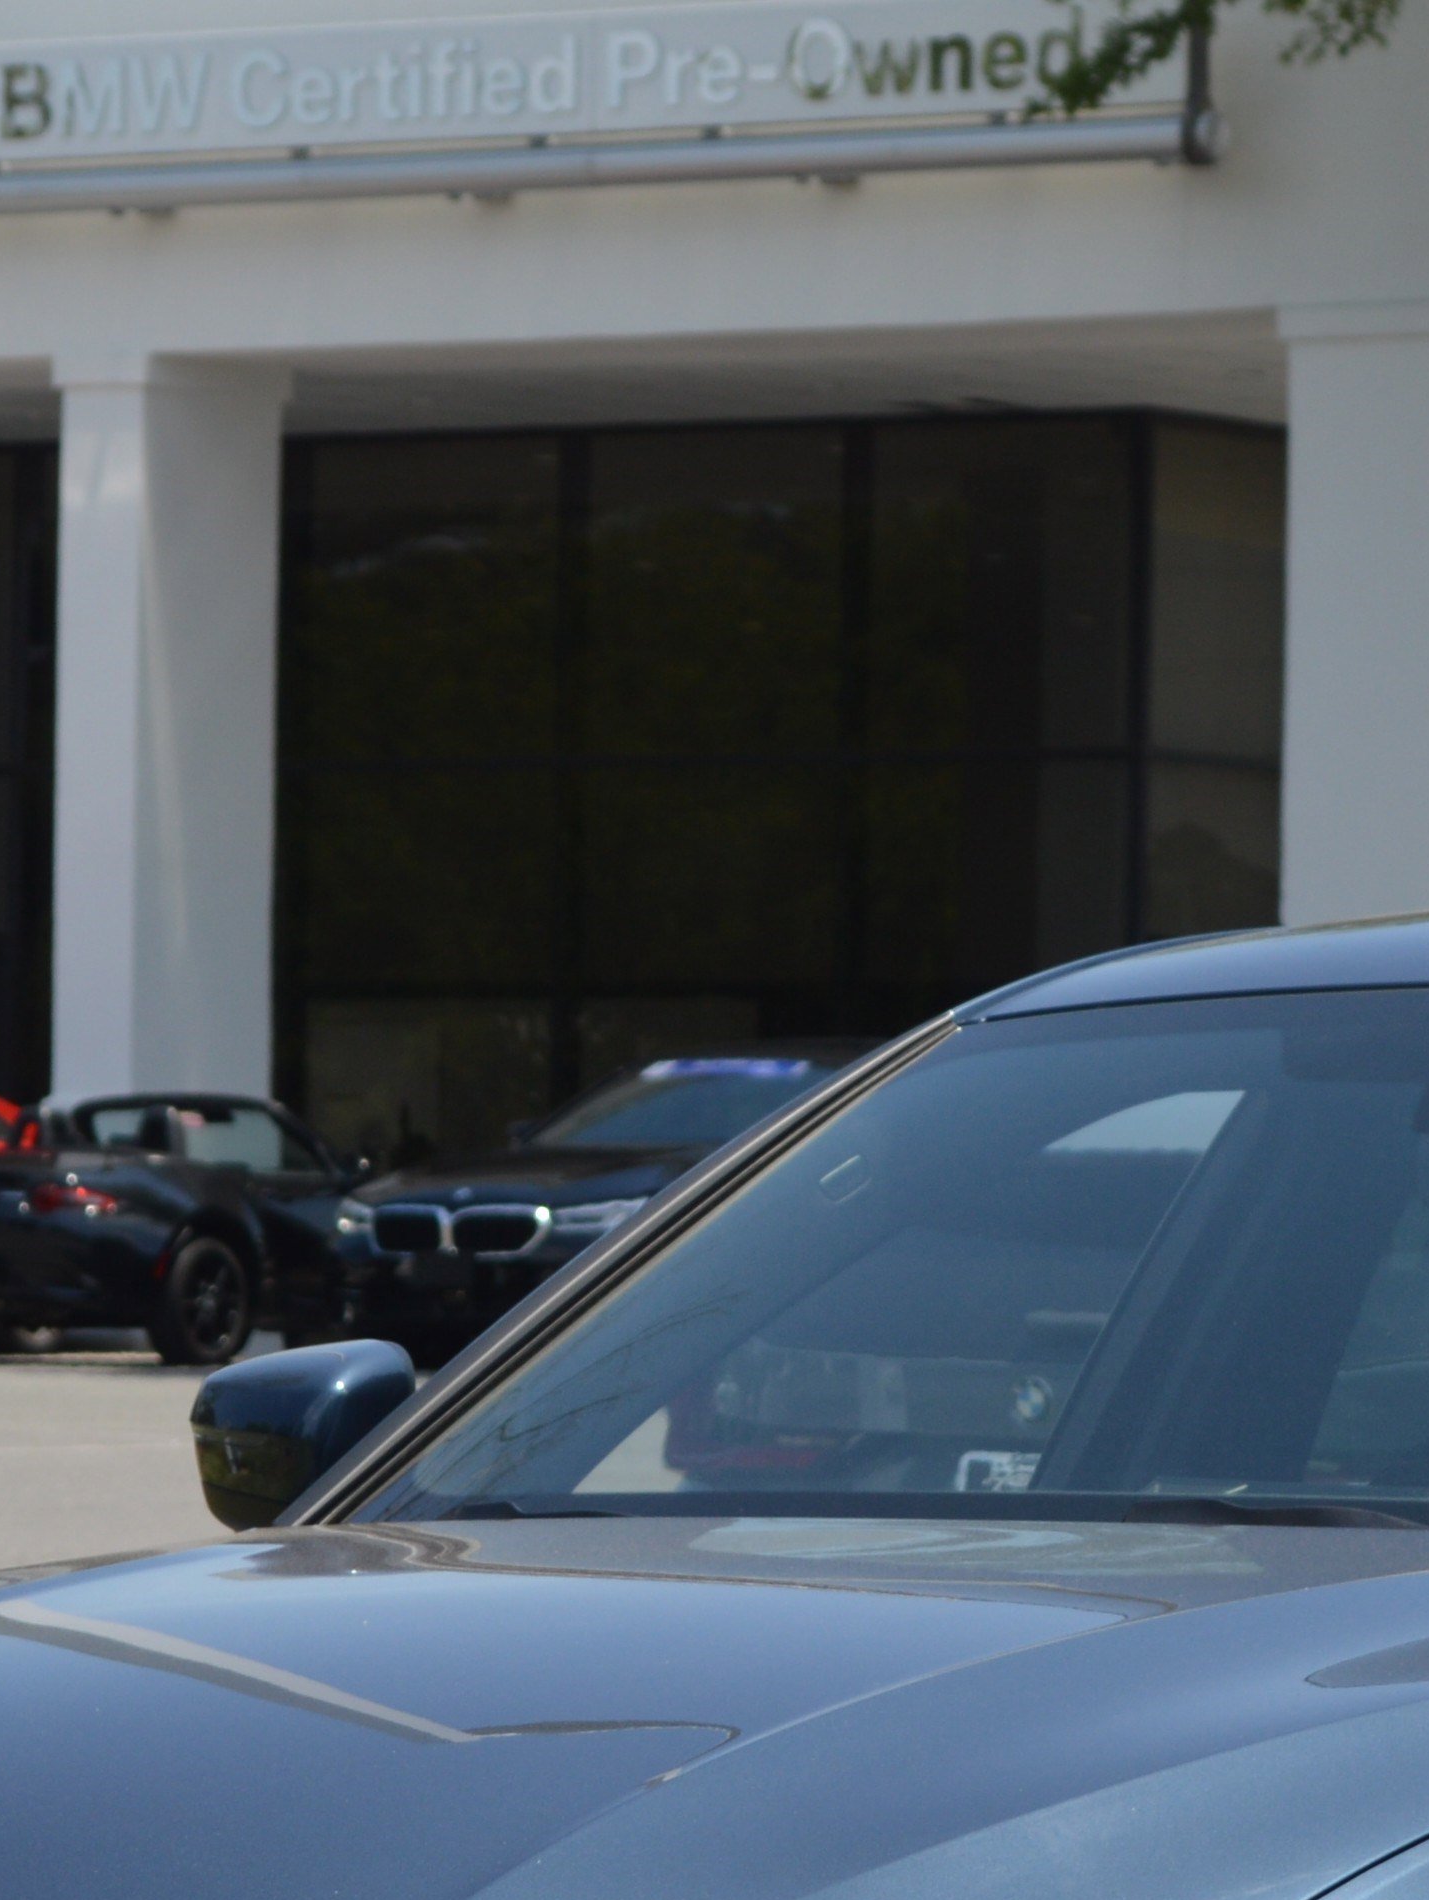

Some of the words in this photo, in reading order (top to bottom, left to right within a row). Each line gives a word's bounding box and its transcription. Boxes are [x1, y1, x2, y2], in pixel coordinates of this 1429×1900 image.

[2, 58, 208, 141] BMW
[235, 38, 579, 127] Certified
[608, 5, 1083, 108] Pre-Owned
